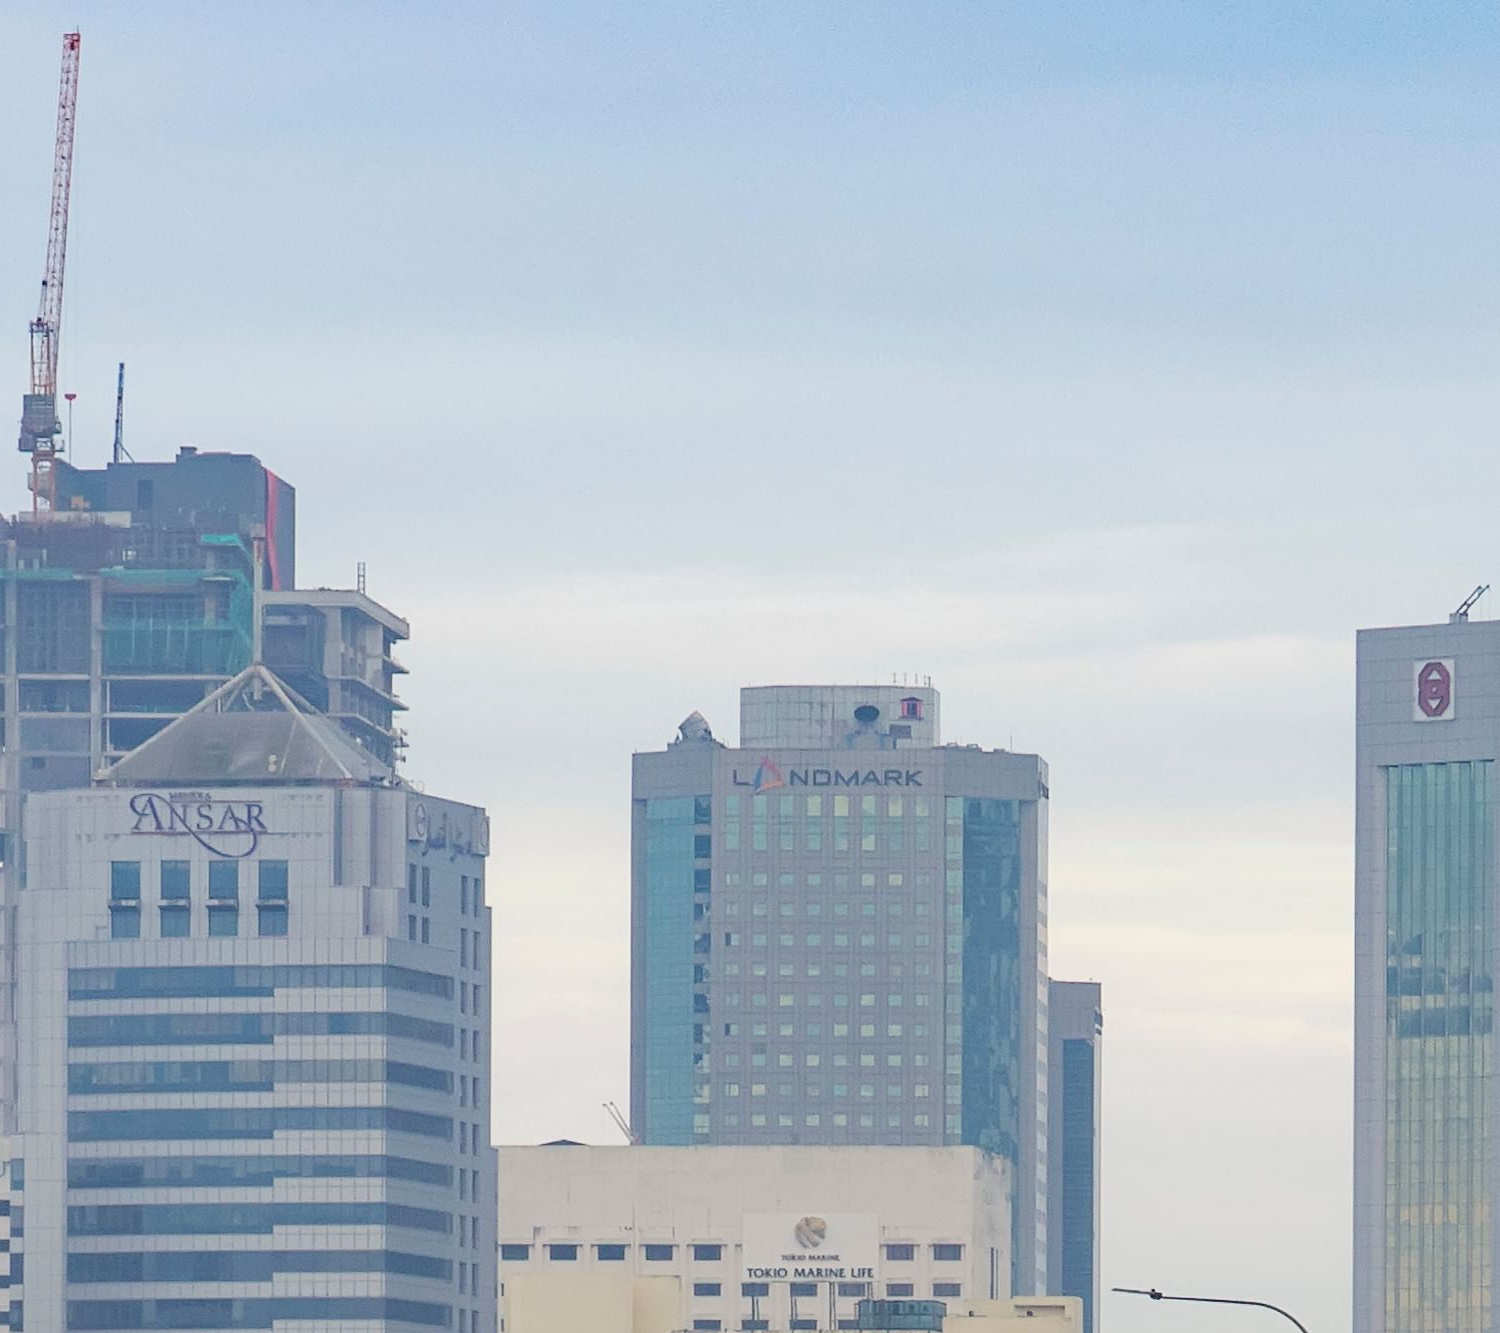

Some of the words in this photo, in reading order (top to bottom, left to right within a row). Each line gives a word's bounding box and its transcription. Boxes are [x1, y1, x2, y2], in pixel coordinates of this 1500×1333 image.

[130, 793, 268, 858] ANSAR
[747, 1268, 788, 1278] TOKIO
[793, 1268, 846, 1278] MARINE
[851, 1268, 874, 1278] LIFE
